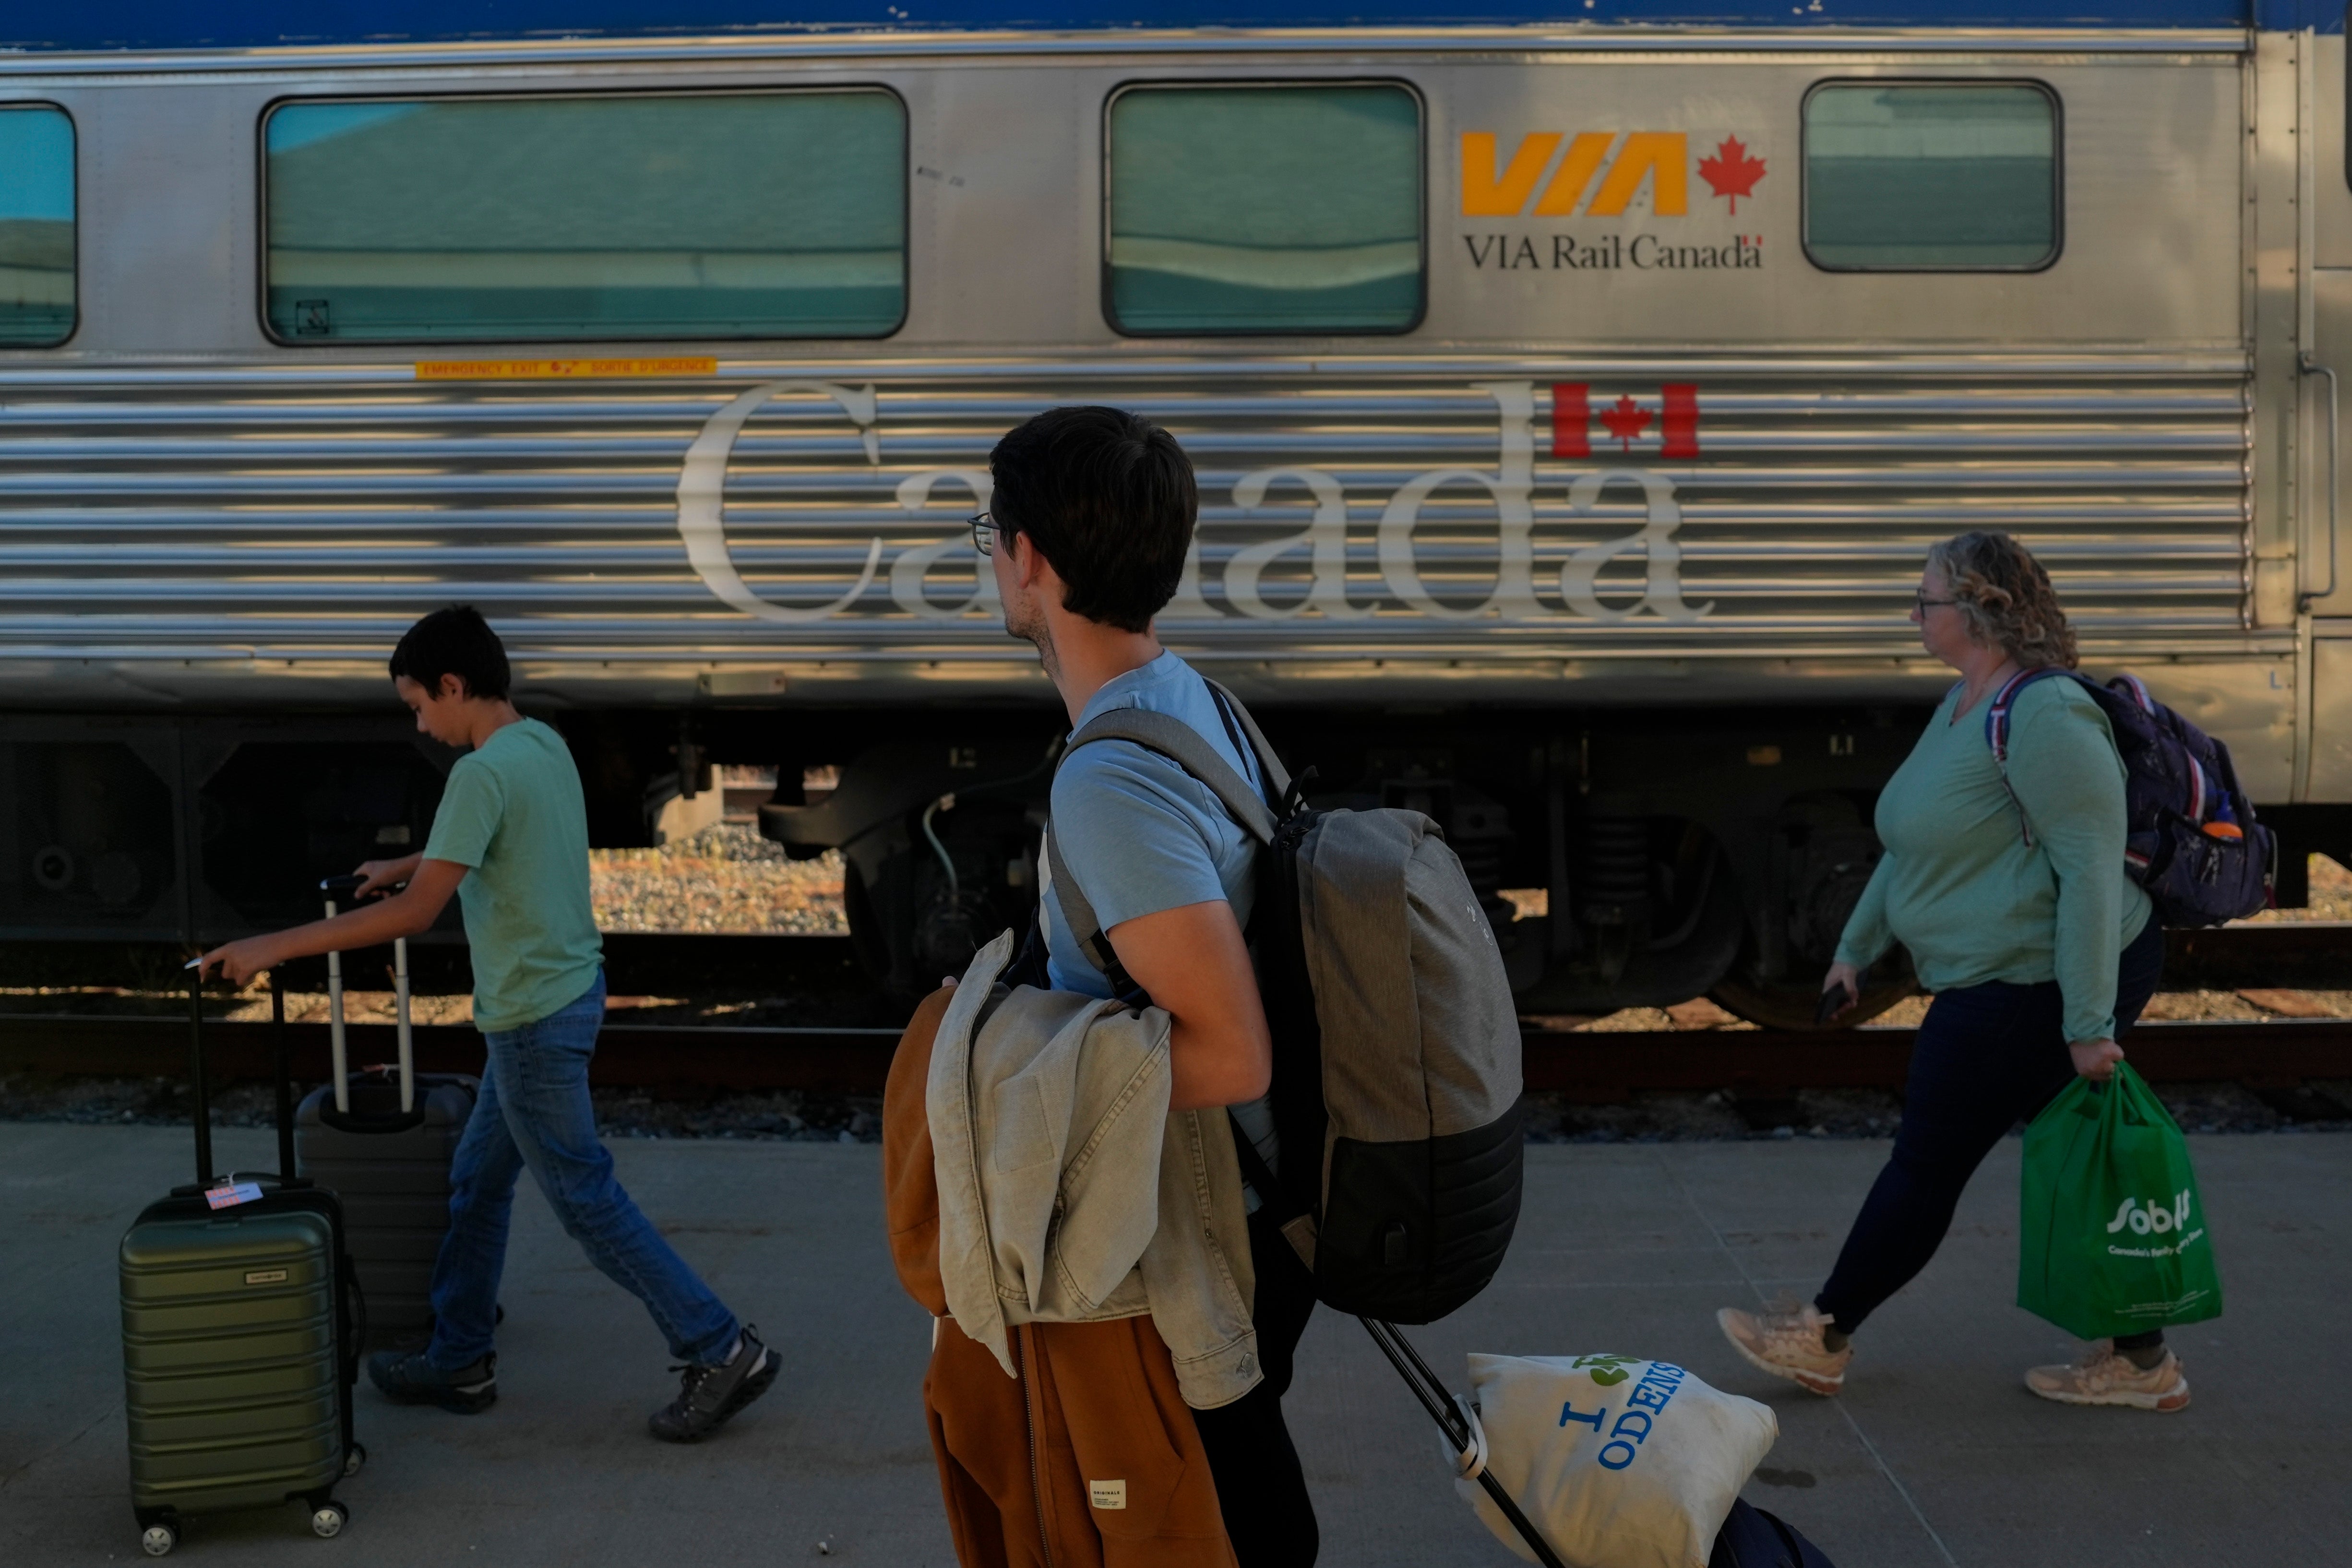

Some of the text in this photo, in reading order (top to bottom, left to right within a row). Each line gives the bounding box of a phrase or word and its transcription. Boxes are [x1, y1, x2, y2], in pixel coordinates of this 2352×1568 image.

[1461, 132, 1688, 216] VIA
[1463, 235, 1762, 270] VIA Rail Canada
[423, 361, 503, 375] EMERGENCY
[511, 361, 539, 375] EXIT
[591, 360, 633, 374] SORTIE
[676, 379, 1715, 624] Caada
[1559, 1401, 1606, 1433] I
[1598, 1362, 1687, 1470] ODENS
